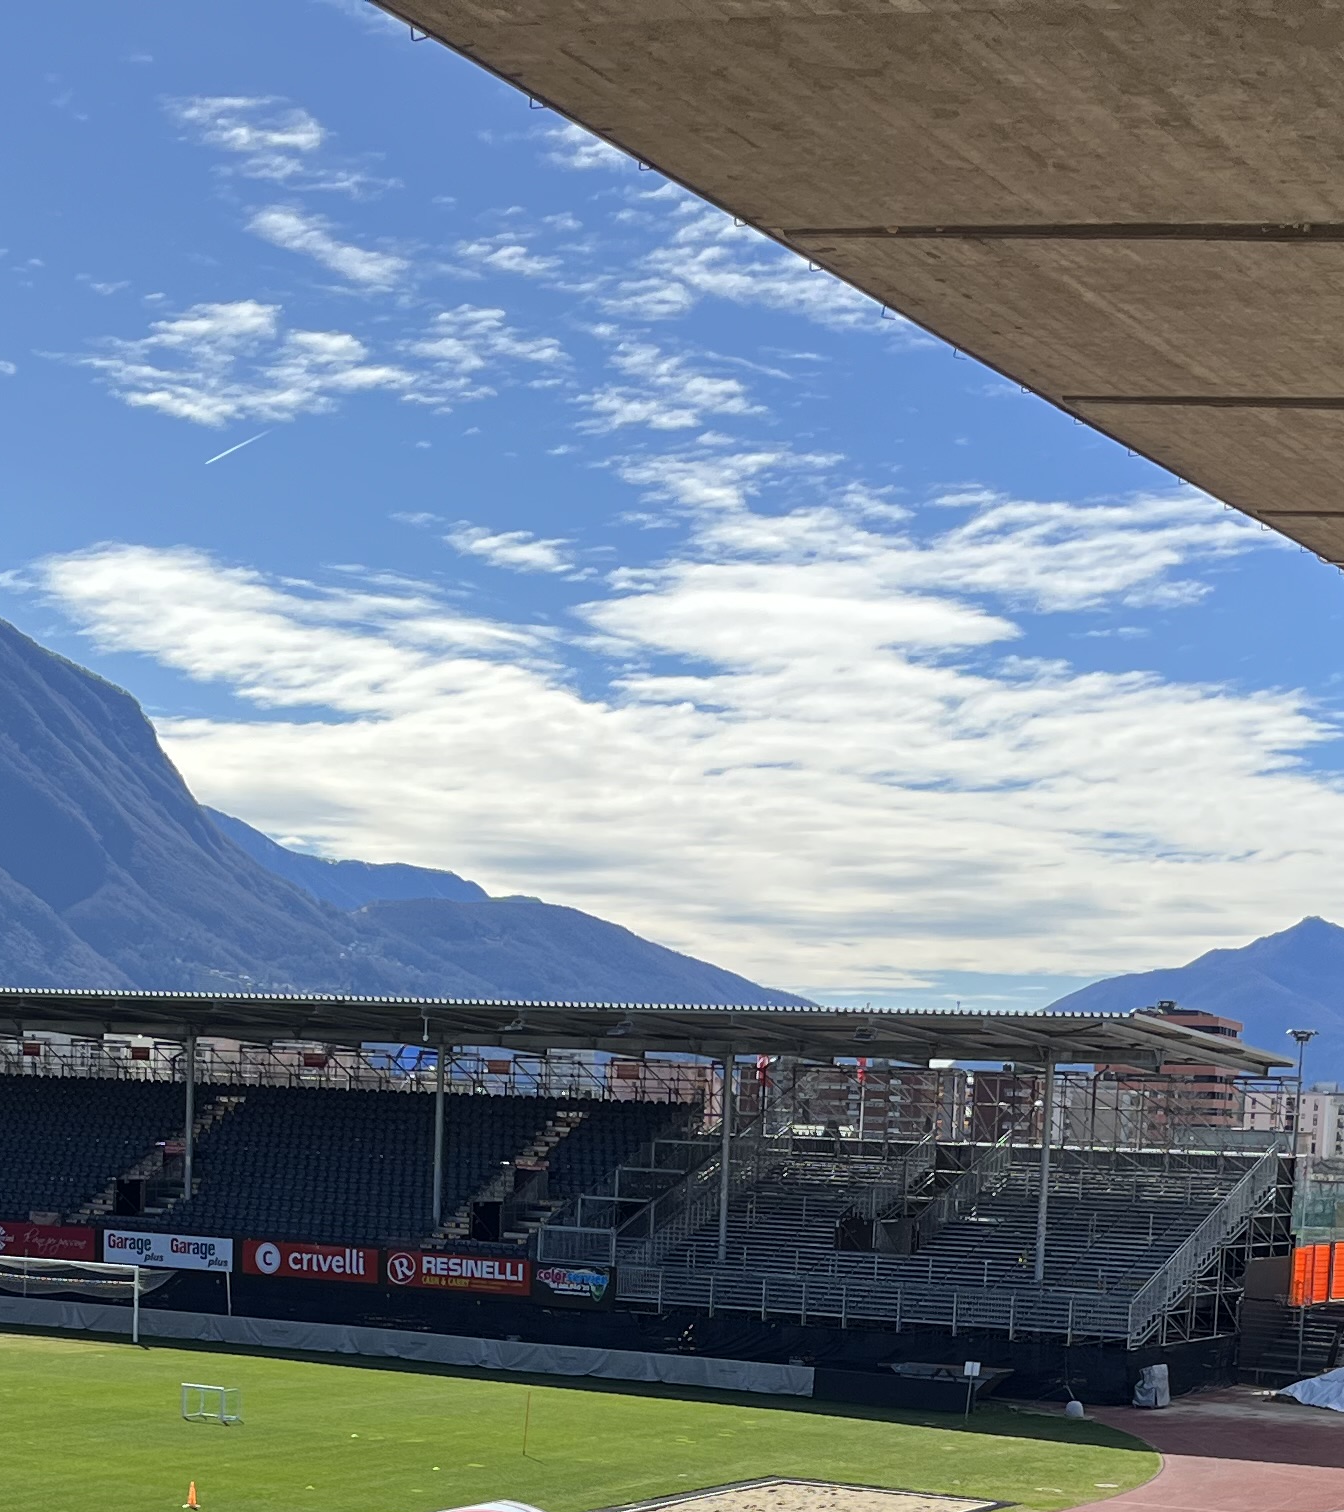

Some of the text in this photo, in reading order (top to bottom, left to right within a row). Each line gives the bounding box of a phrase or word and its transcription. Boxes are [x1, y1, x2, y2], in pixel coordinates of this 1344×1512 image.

[107, 1233, 152, 1256] Garage
[170, 1238, 216, 1259] Garage
[144, 1252, 164, 1263] plus
[208, 1257, 229, 1268] plus
[288, 1247, 365, 1276] crivelli
[422, 1256, 523, 1282] RESINELLI
